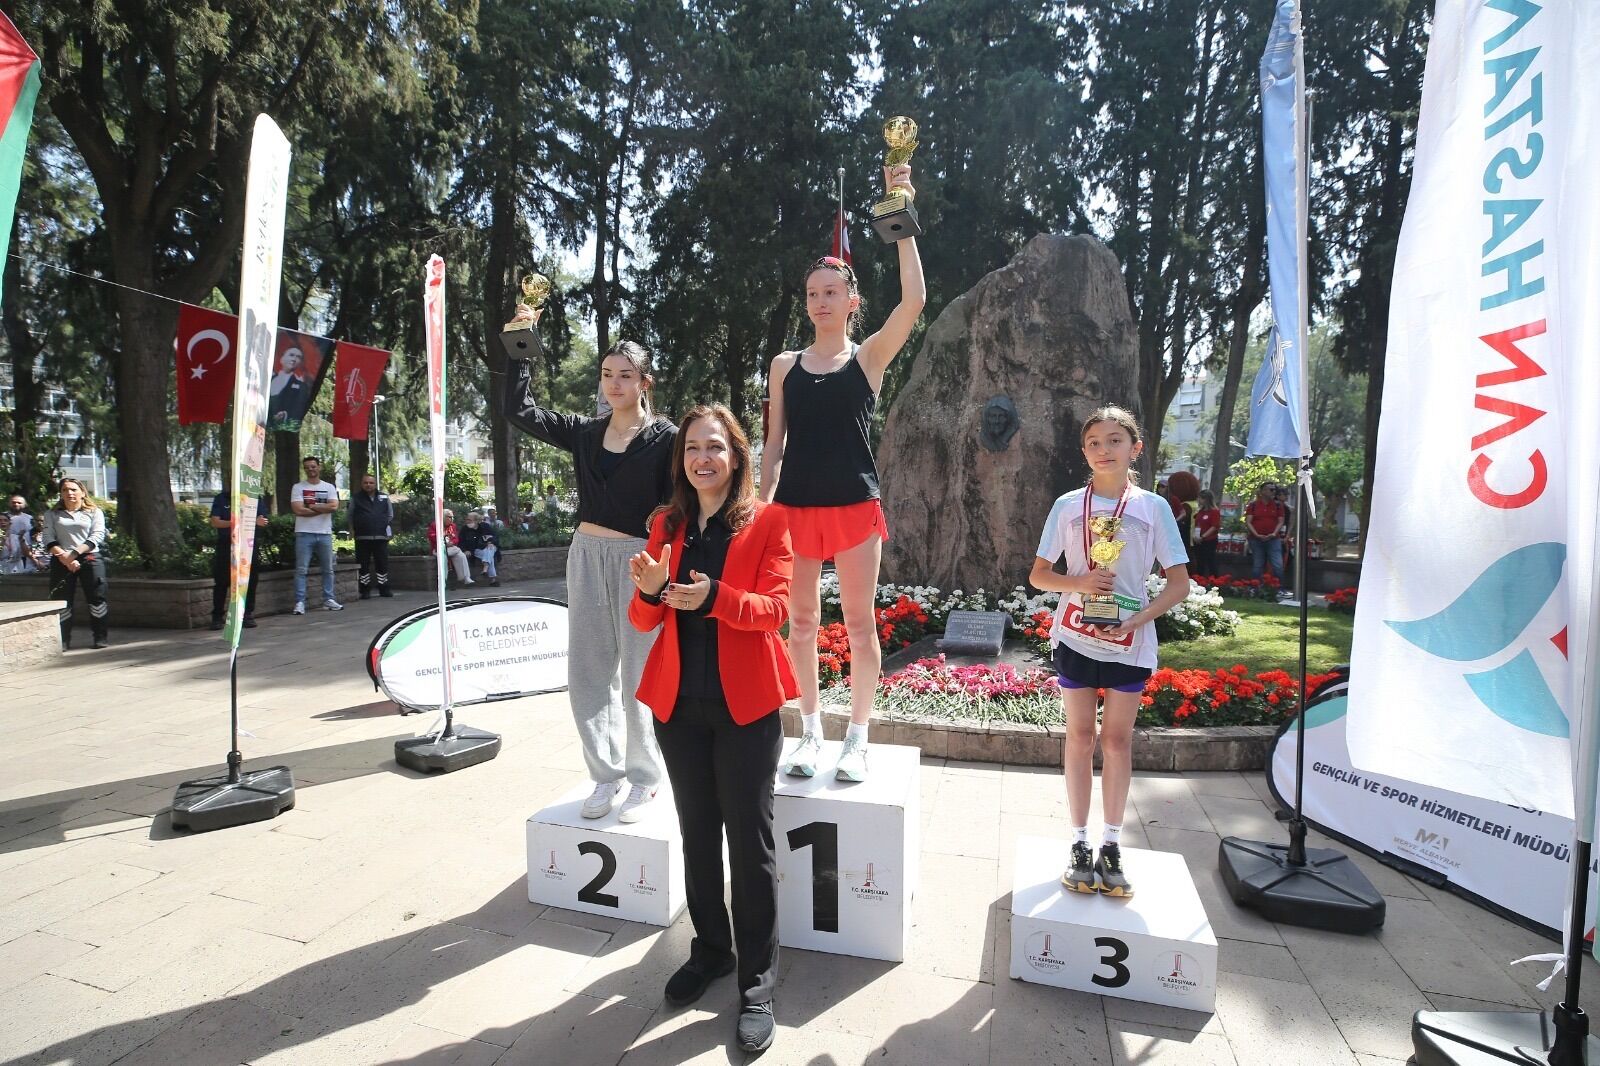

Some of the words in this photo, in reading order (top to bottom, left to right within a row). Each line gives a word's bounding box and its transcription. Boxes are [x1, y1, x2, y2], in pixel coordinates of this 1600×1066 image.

[463, 628, 483, 639] T.C.
[486, 622, 548, 636] KARŞIYAKA
[479, 636, 537, 651] BELEDİYESİ
[452, 664, 462, 672] VE
[464, 661, 485, 671] SPOR
[1312, 761, 1361, 787] GENÇLİK
[1363, 778, 1380, 794] VE
[1381, 786, 1418, 808] SPOR
[1420, 799, 1512, 841] HİZMETLERİ
[577, 840, 618, 908] 2
[786, 821, 839, 934] 1
[1091, 936, 1131, 988] 3
